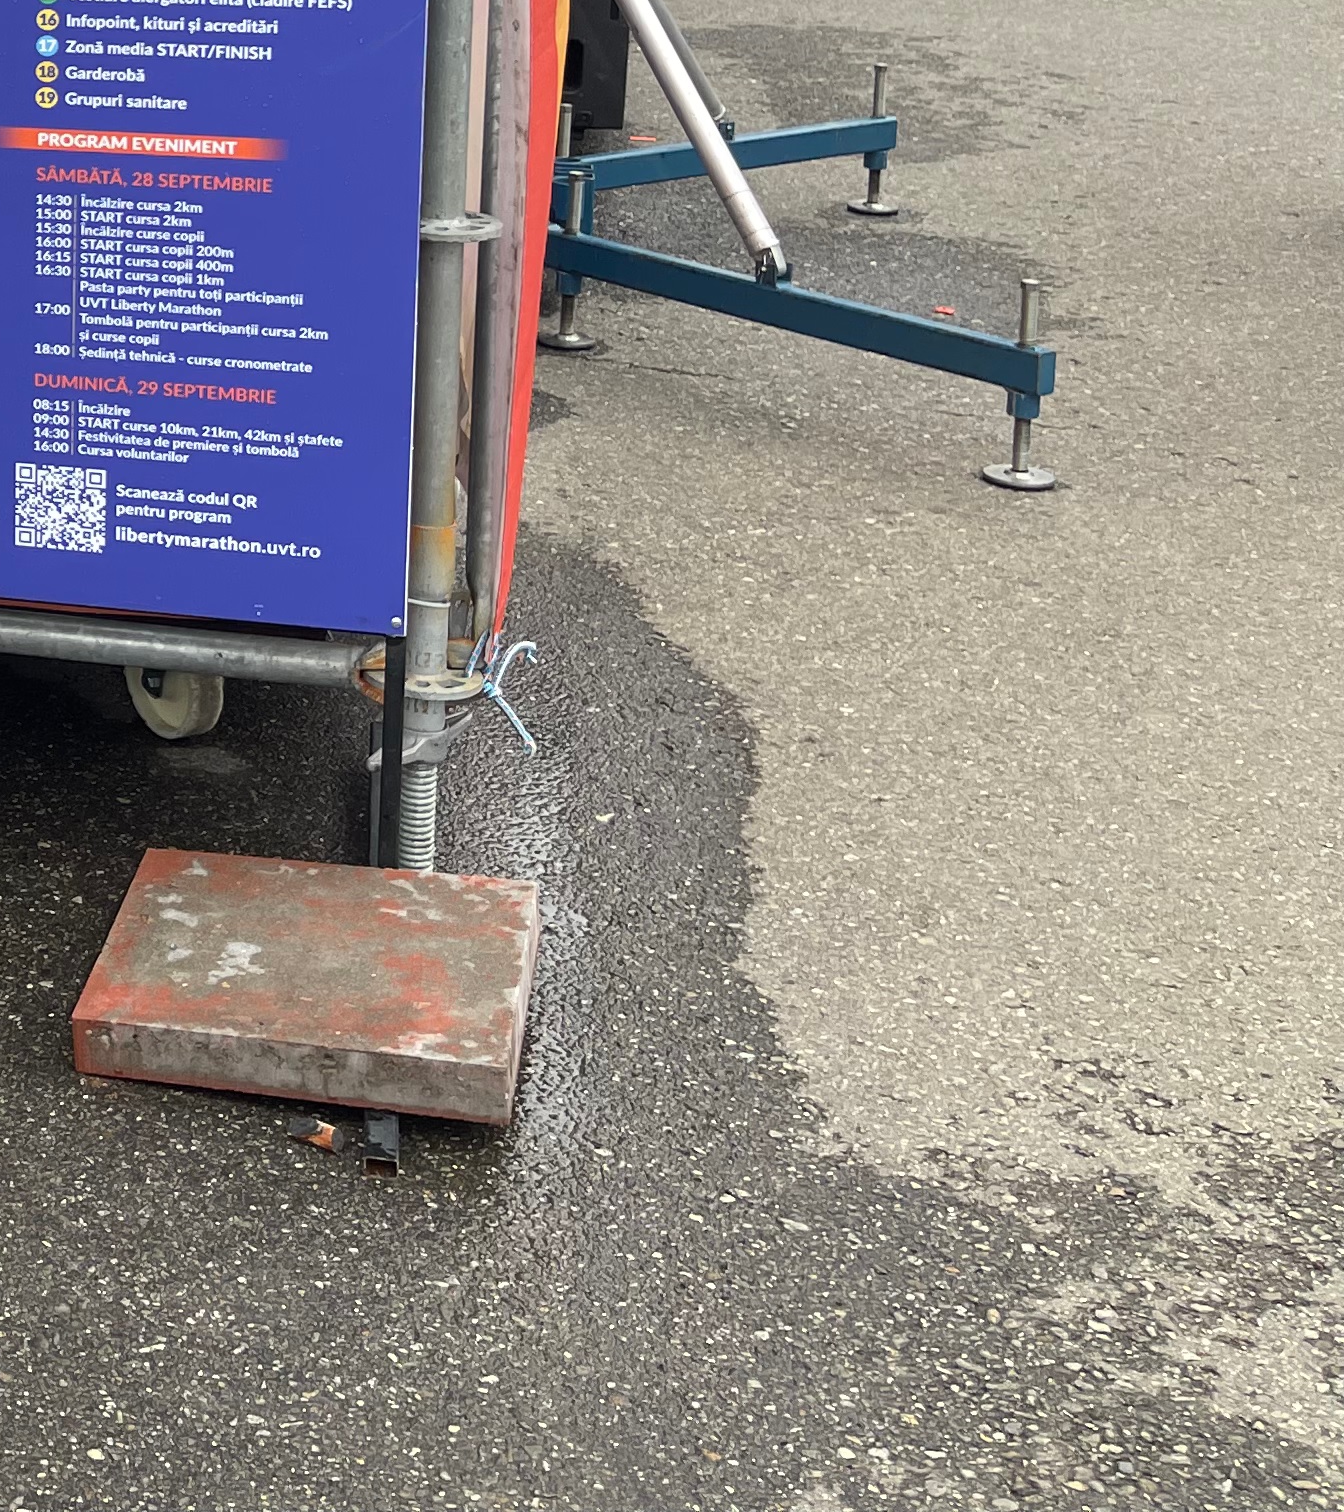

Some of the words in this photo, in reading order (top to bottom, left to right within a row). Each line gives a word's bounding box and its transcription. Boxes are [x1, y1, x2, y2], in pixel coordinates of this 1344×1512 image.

[38, 66, 56, 78] 18
[65, 65, 145, 82] Garderobă
[38, 91, 56, 104] 19
[64, 92, 123, 109] Grupuri
[126, 95, 188, 110] sanitare
[37, 132, 128, 151] PROGRAM
[132, 136, 238, 156] EVENIMENT
[36, 165, 128, 187] SÂMBĂTĂ,
[131, 172, 154, 188] 28
[157, 174, 273, 193] SEPTEMBRIE
[35, 193, 73, 207] 14:30
[80, 193, 135, 211] Încălzire
[136, 199, 171, 212] cursa
[173, 200, 203, 214] 2km
[34, 373, 134, 396] DUMINICĂ,
[137, 381, 159, 396] 29
[163, 383, 277, 405] SEPTEMBRIE
[116, 484, 185, 503] Scanează
[188, 490, 230, 507] codul
[232, 494, 258, 510] QR
[115, 503, 166, 520] pentru
[169, 508, 232, 526] program
[115, 526, 322, 560] libertymarathon.uvt.ro
